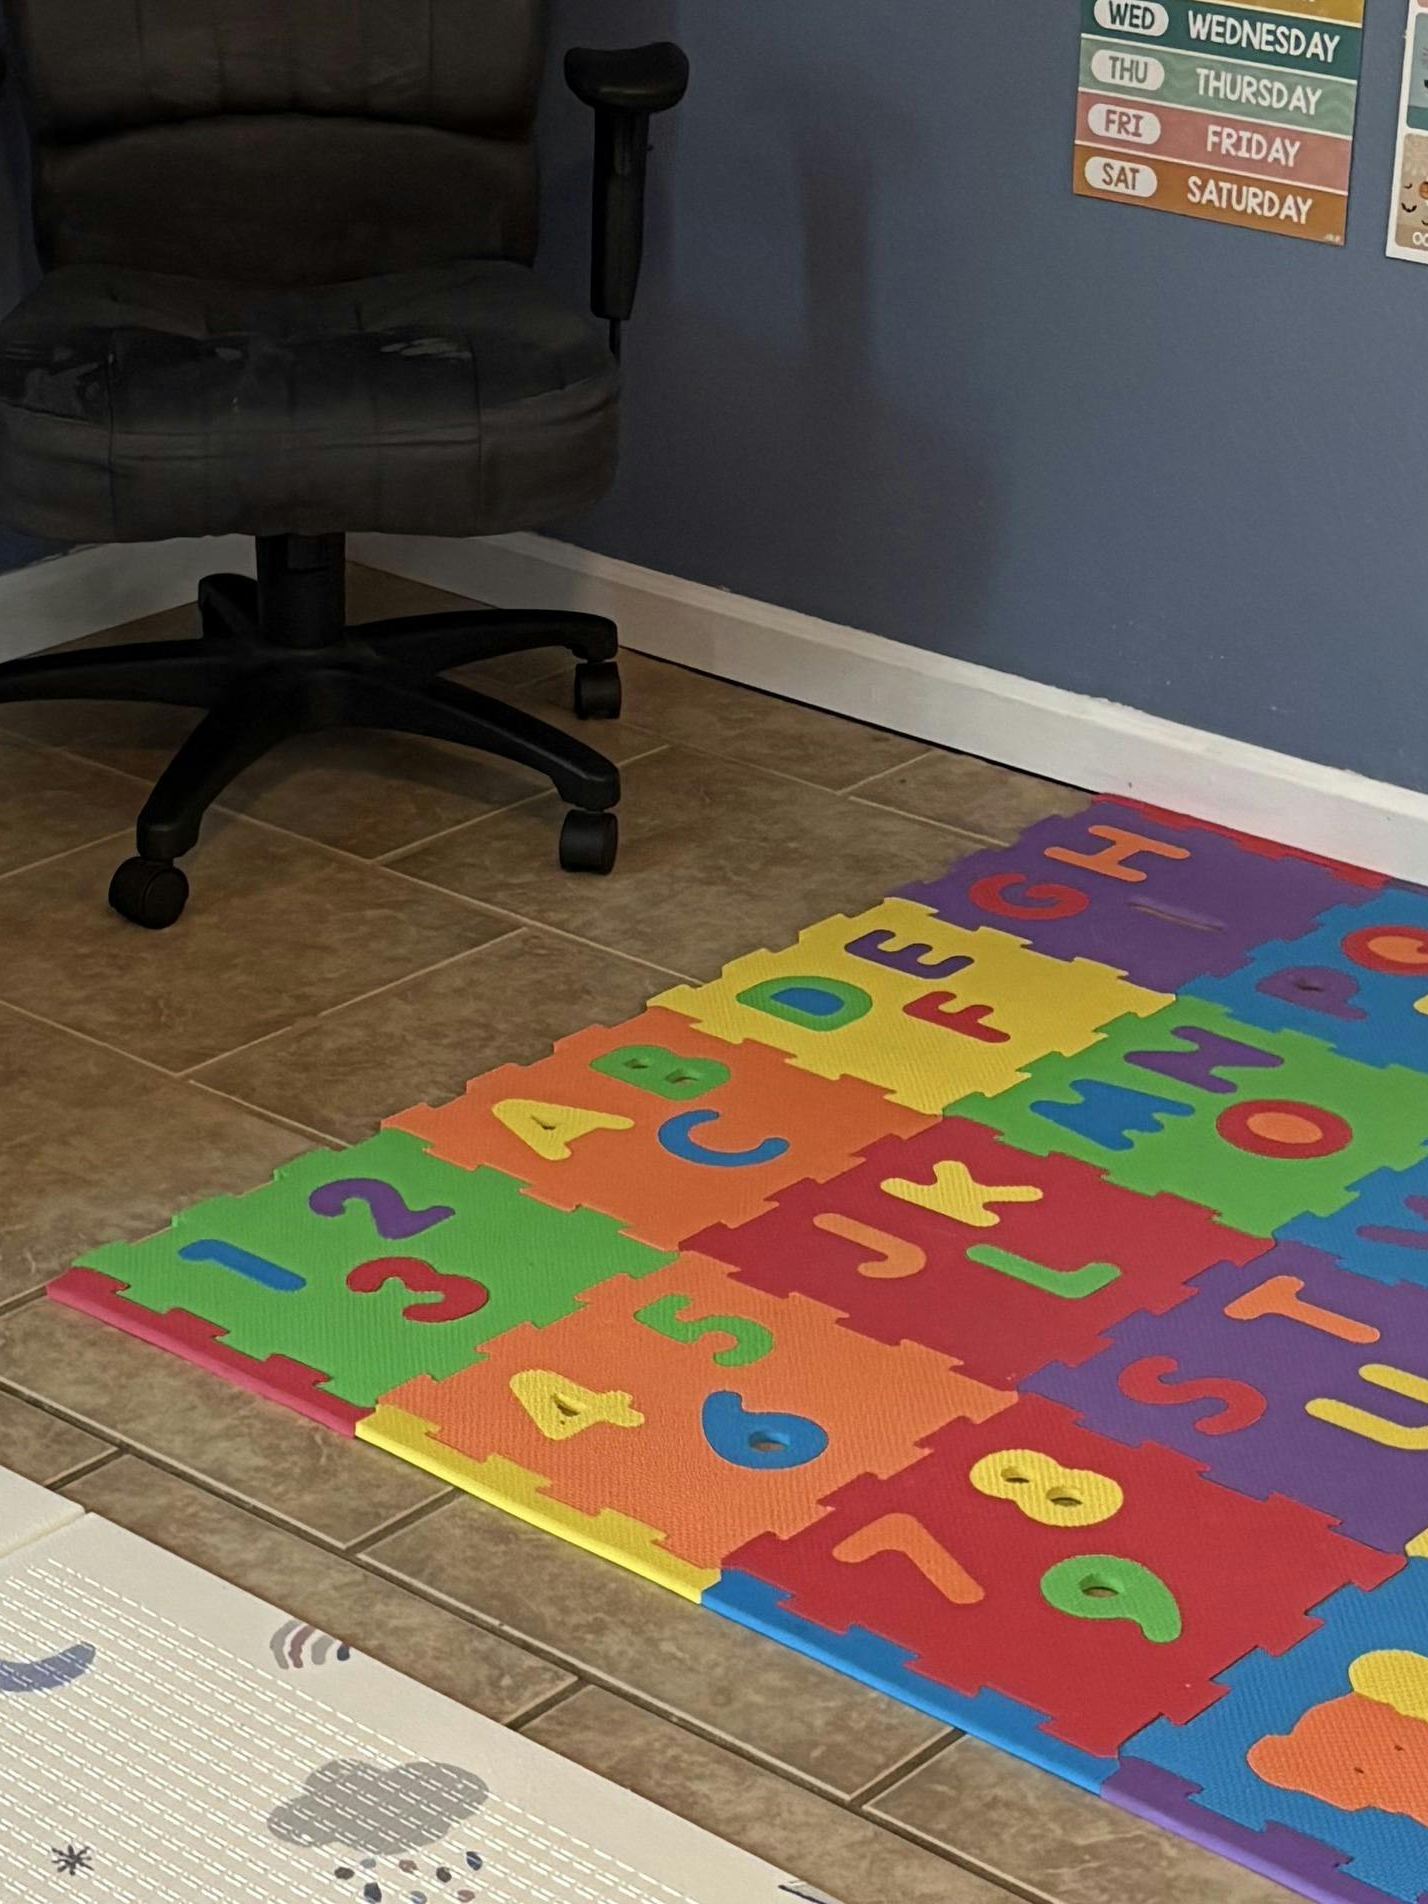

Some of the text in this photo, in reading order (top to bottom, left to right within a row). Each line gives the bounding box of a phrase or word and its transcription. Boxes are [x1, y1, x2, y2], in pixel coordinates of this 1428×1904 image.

[1108, 0, 1340, 62] WED WEDNESDAY
[1108, 56, 1322, 115] THU THURSDAY
[1104, 109, 1300, 167] FRI FRIDAY
[1102, 162, 1312, 224] SAT SATURDAY
